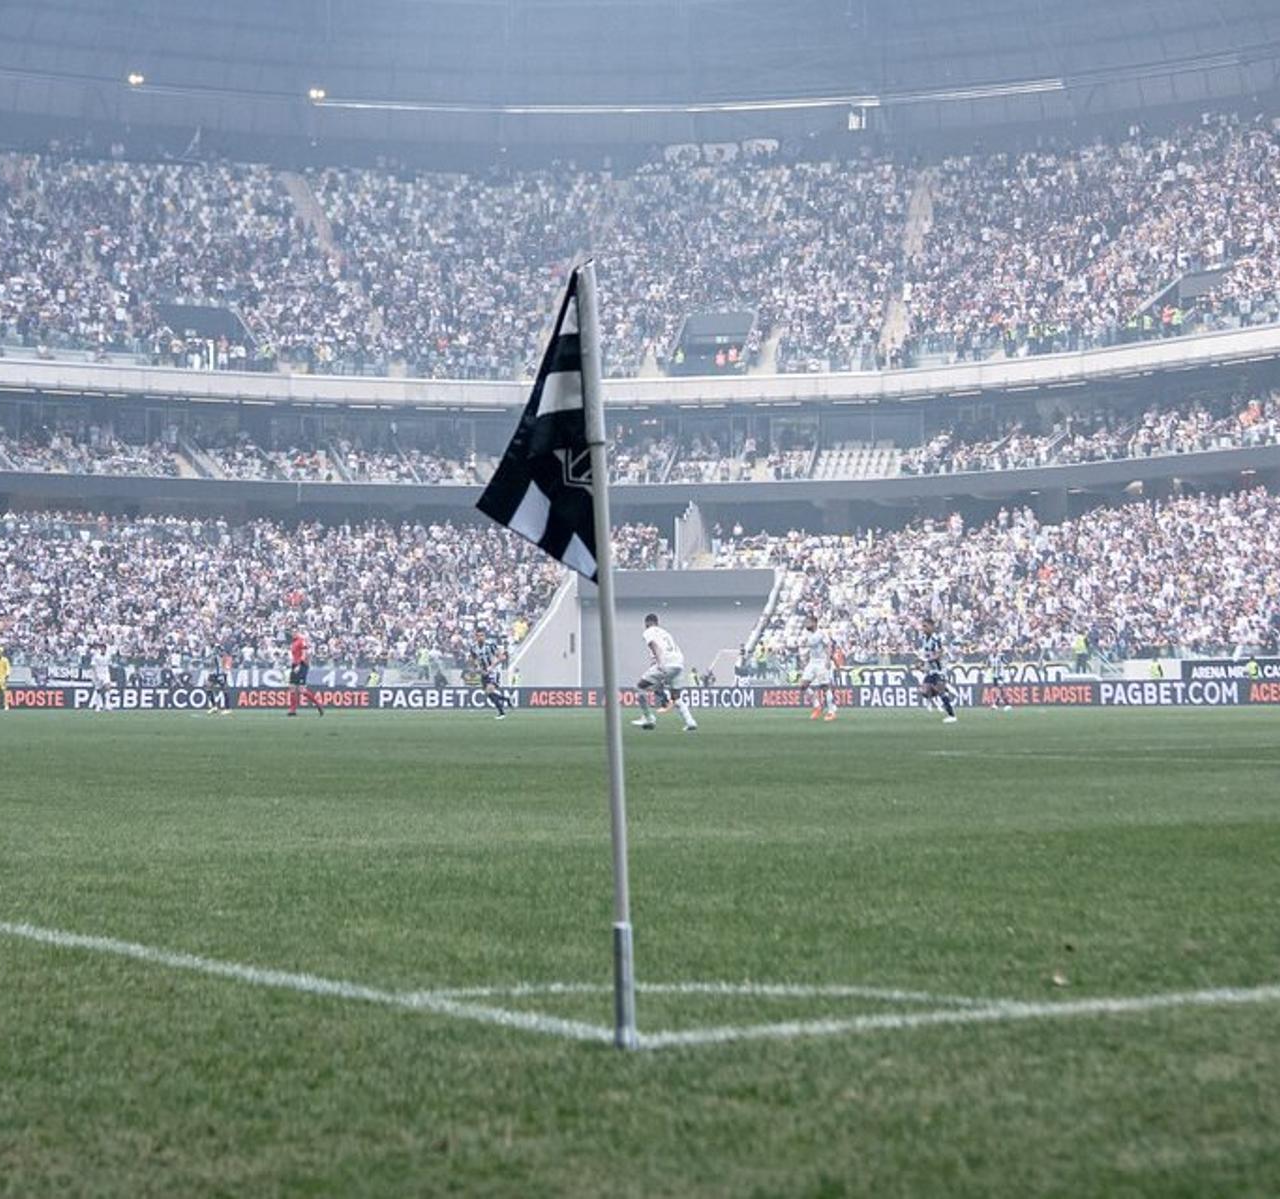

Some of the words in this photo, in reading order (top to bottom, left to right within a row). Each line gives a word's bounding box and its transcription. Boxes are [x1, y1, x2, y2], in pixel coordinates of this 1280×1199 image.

[530, 691, 583, 706] ACESSE
[588, 691, 596, 706] E
[762, 689, 801, 705] ACESSE
[1032, 686, 1040, 703] E
[1043, 685, 1092, 703] APOSTE
[1100, 680, 1238, 705] PAGBET.COM
